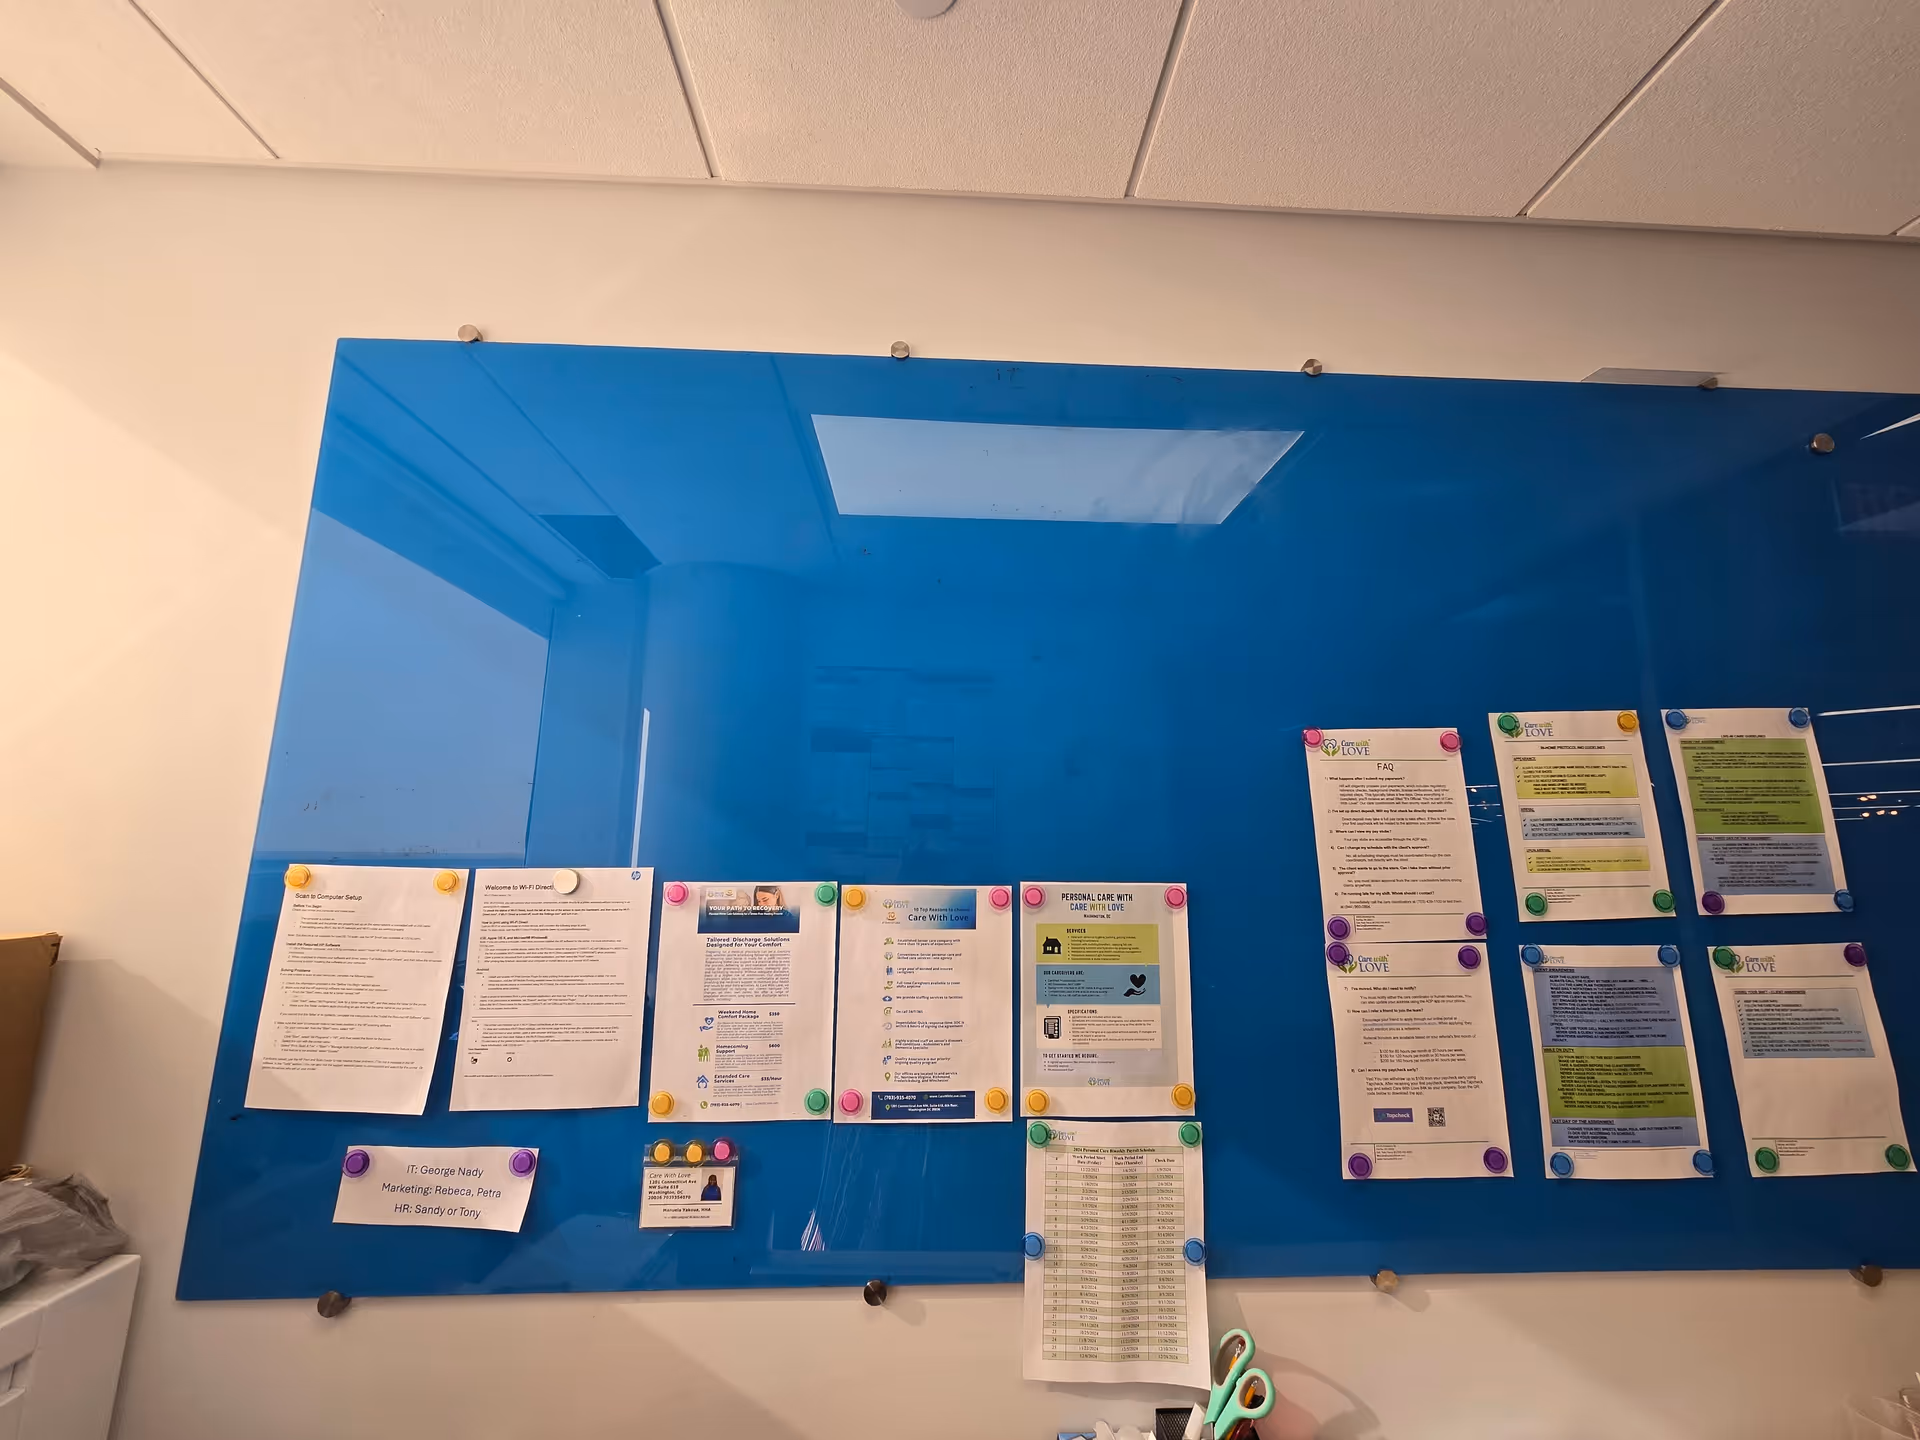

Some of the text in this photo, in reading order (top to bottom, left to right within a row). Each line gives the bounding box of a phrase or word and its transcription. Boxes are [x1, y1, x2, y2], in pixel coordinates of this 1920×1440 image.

[1525, 728, 1554, 737] LOVE
[1341, 739, 1355, 747] Care
[1341, 747, 1370, 756] LOVE
[1377, 763, 1394, 772] FAQ
[631, 870, 641, 881] hp
[317, 893, 345, 901] Computer
[1061, 893, 1133, 901] PERSONAL CARE WITH
[1069, 903, 1125, 911] CARE WITH LOVE
[907, 914, 969, 922] Care With Love
[1359, 962, 1390, 973] LOVE
[1746, 962, 1777, 972] LOVE
[406, 1164, 483, 1178] IT: George Nady
[381, 1183, 502, 1198] Marketing: Rebeca, Petra
[394, 1204, 481, 1219] HR: Sandy or Tony
